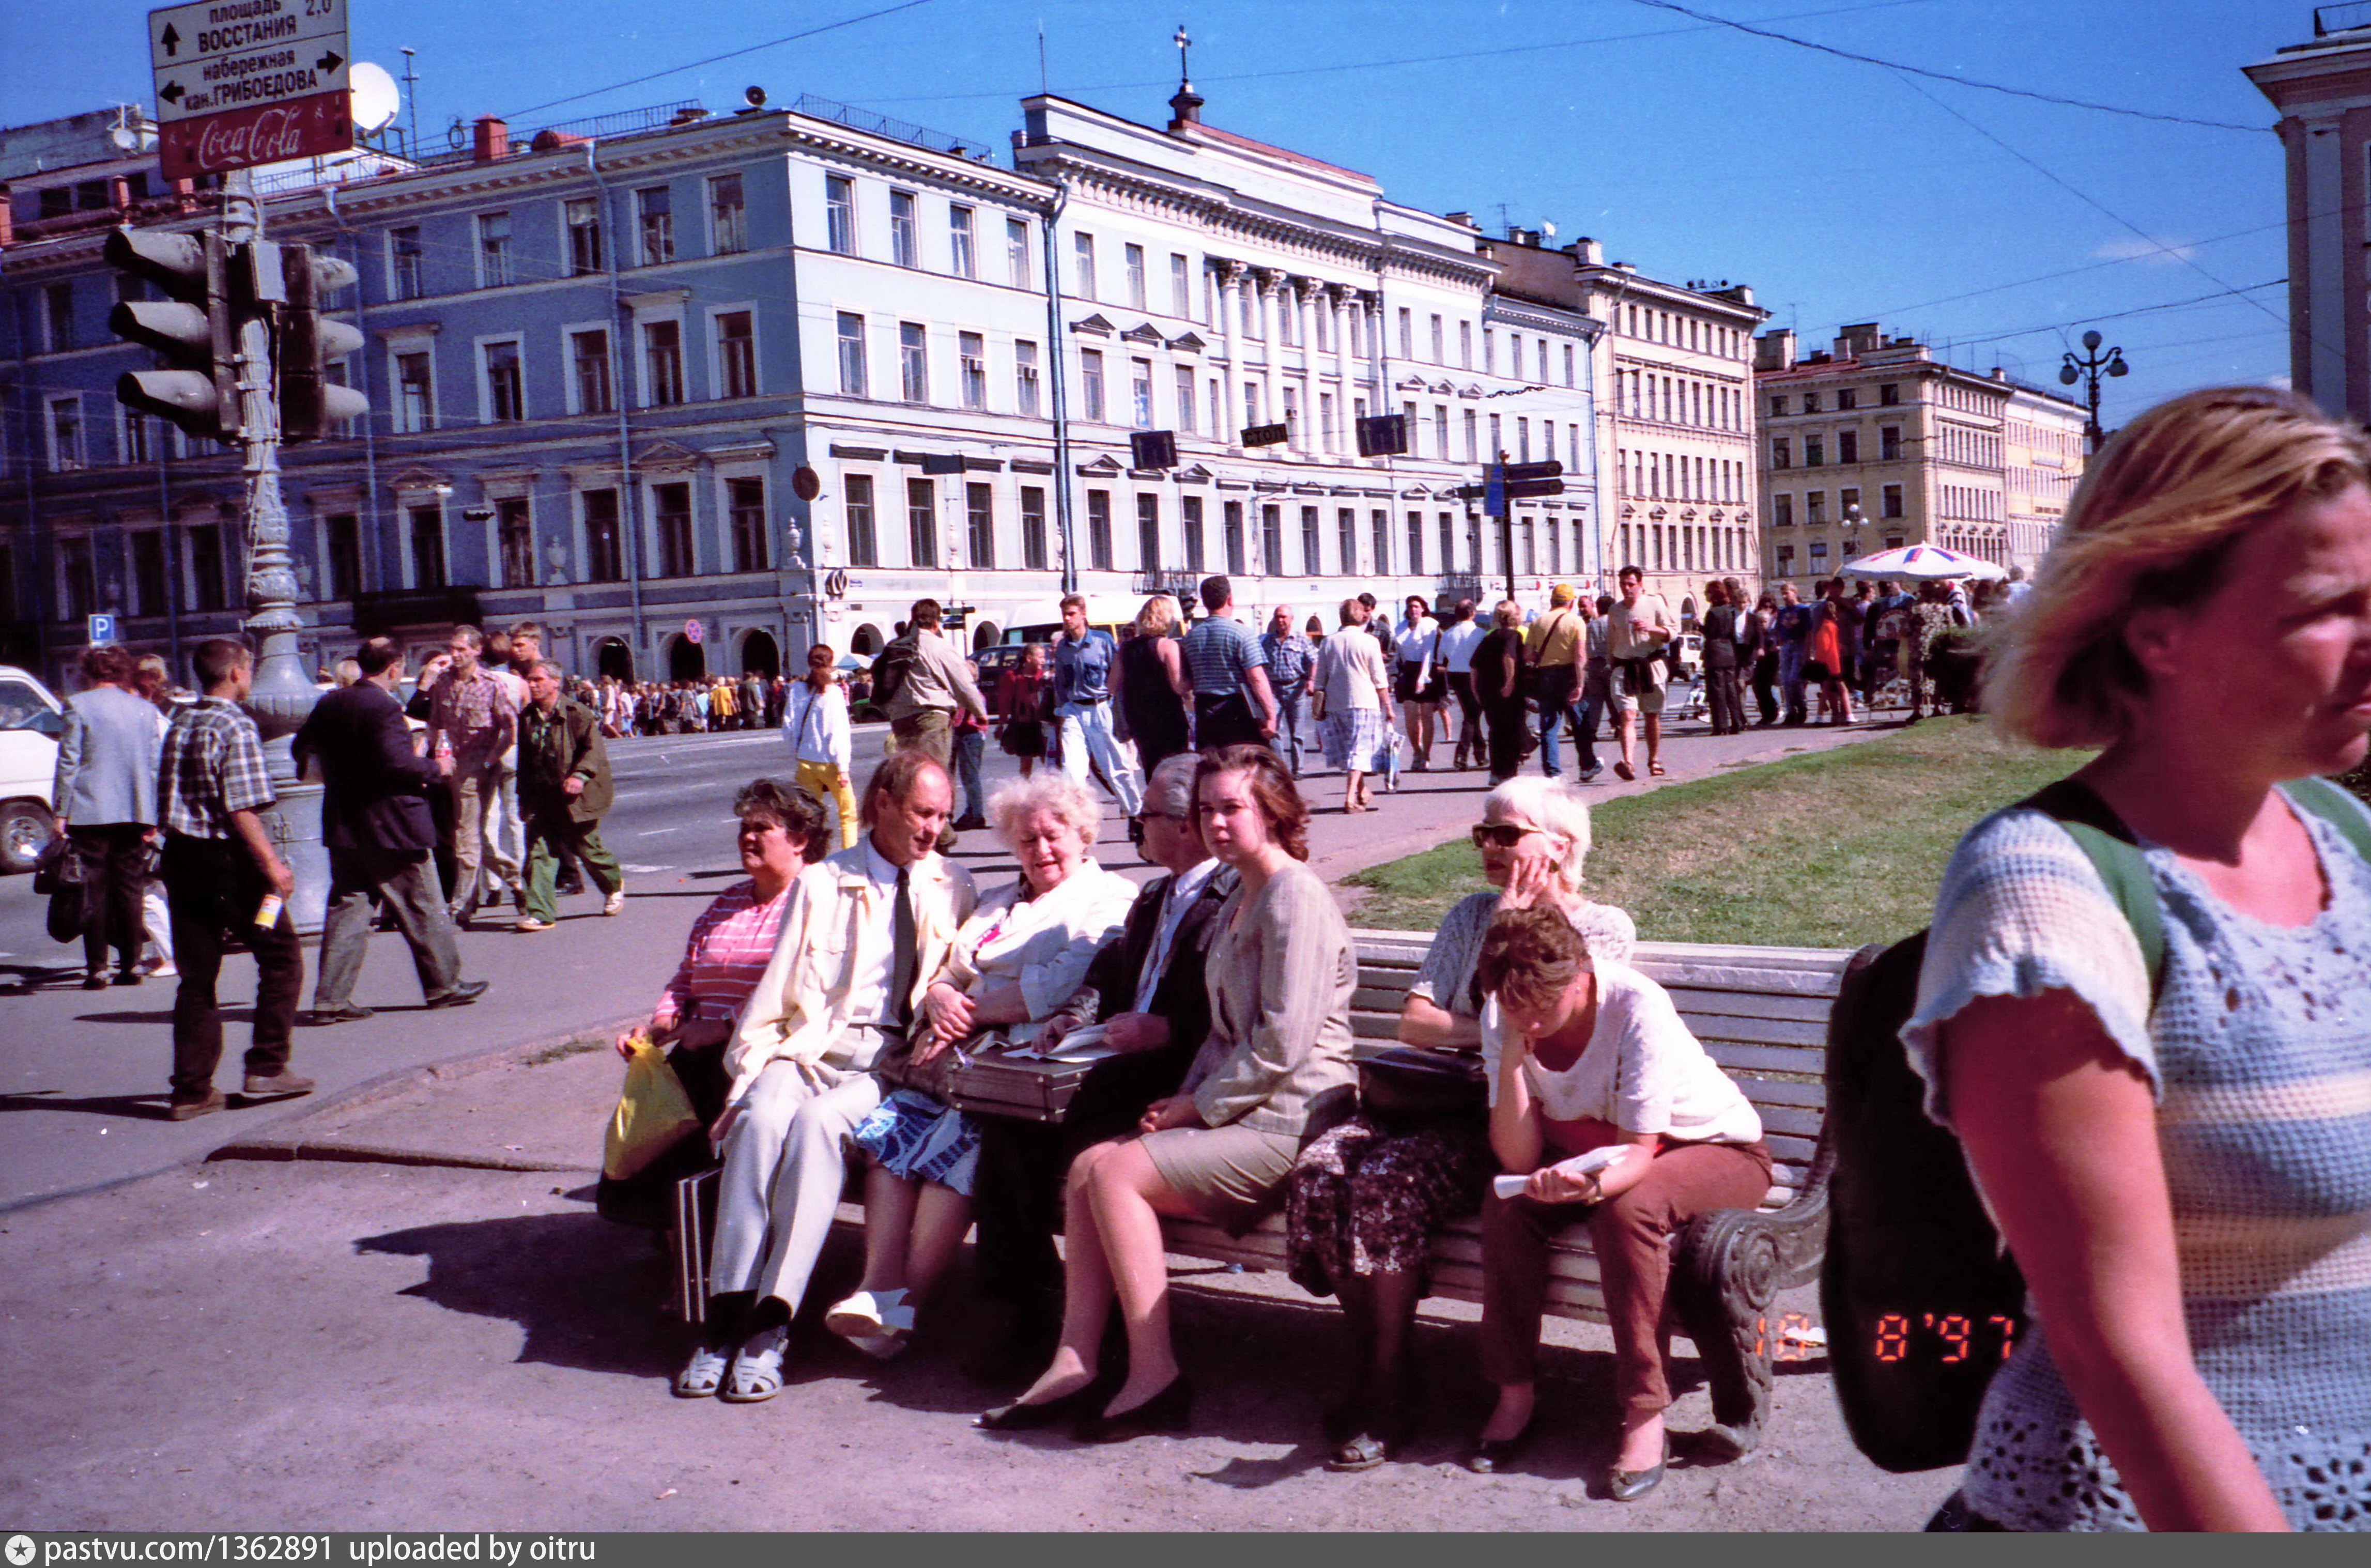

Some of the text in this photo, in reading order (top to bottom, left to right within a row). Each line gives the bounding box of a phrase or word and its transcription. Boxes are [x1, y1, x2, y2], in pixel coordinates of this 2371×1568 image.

[209, 0, 282, 24] площадь
[198, 14, 297, 53] ВОССТАНИЯ
[203, 50, 296, 81] набережная
[1244, 426, 1285, 444] СТОП
[96, 618, 109, 638] P
